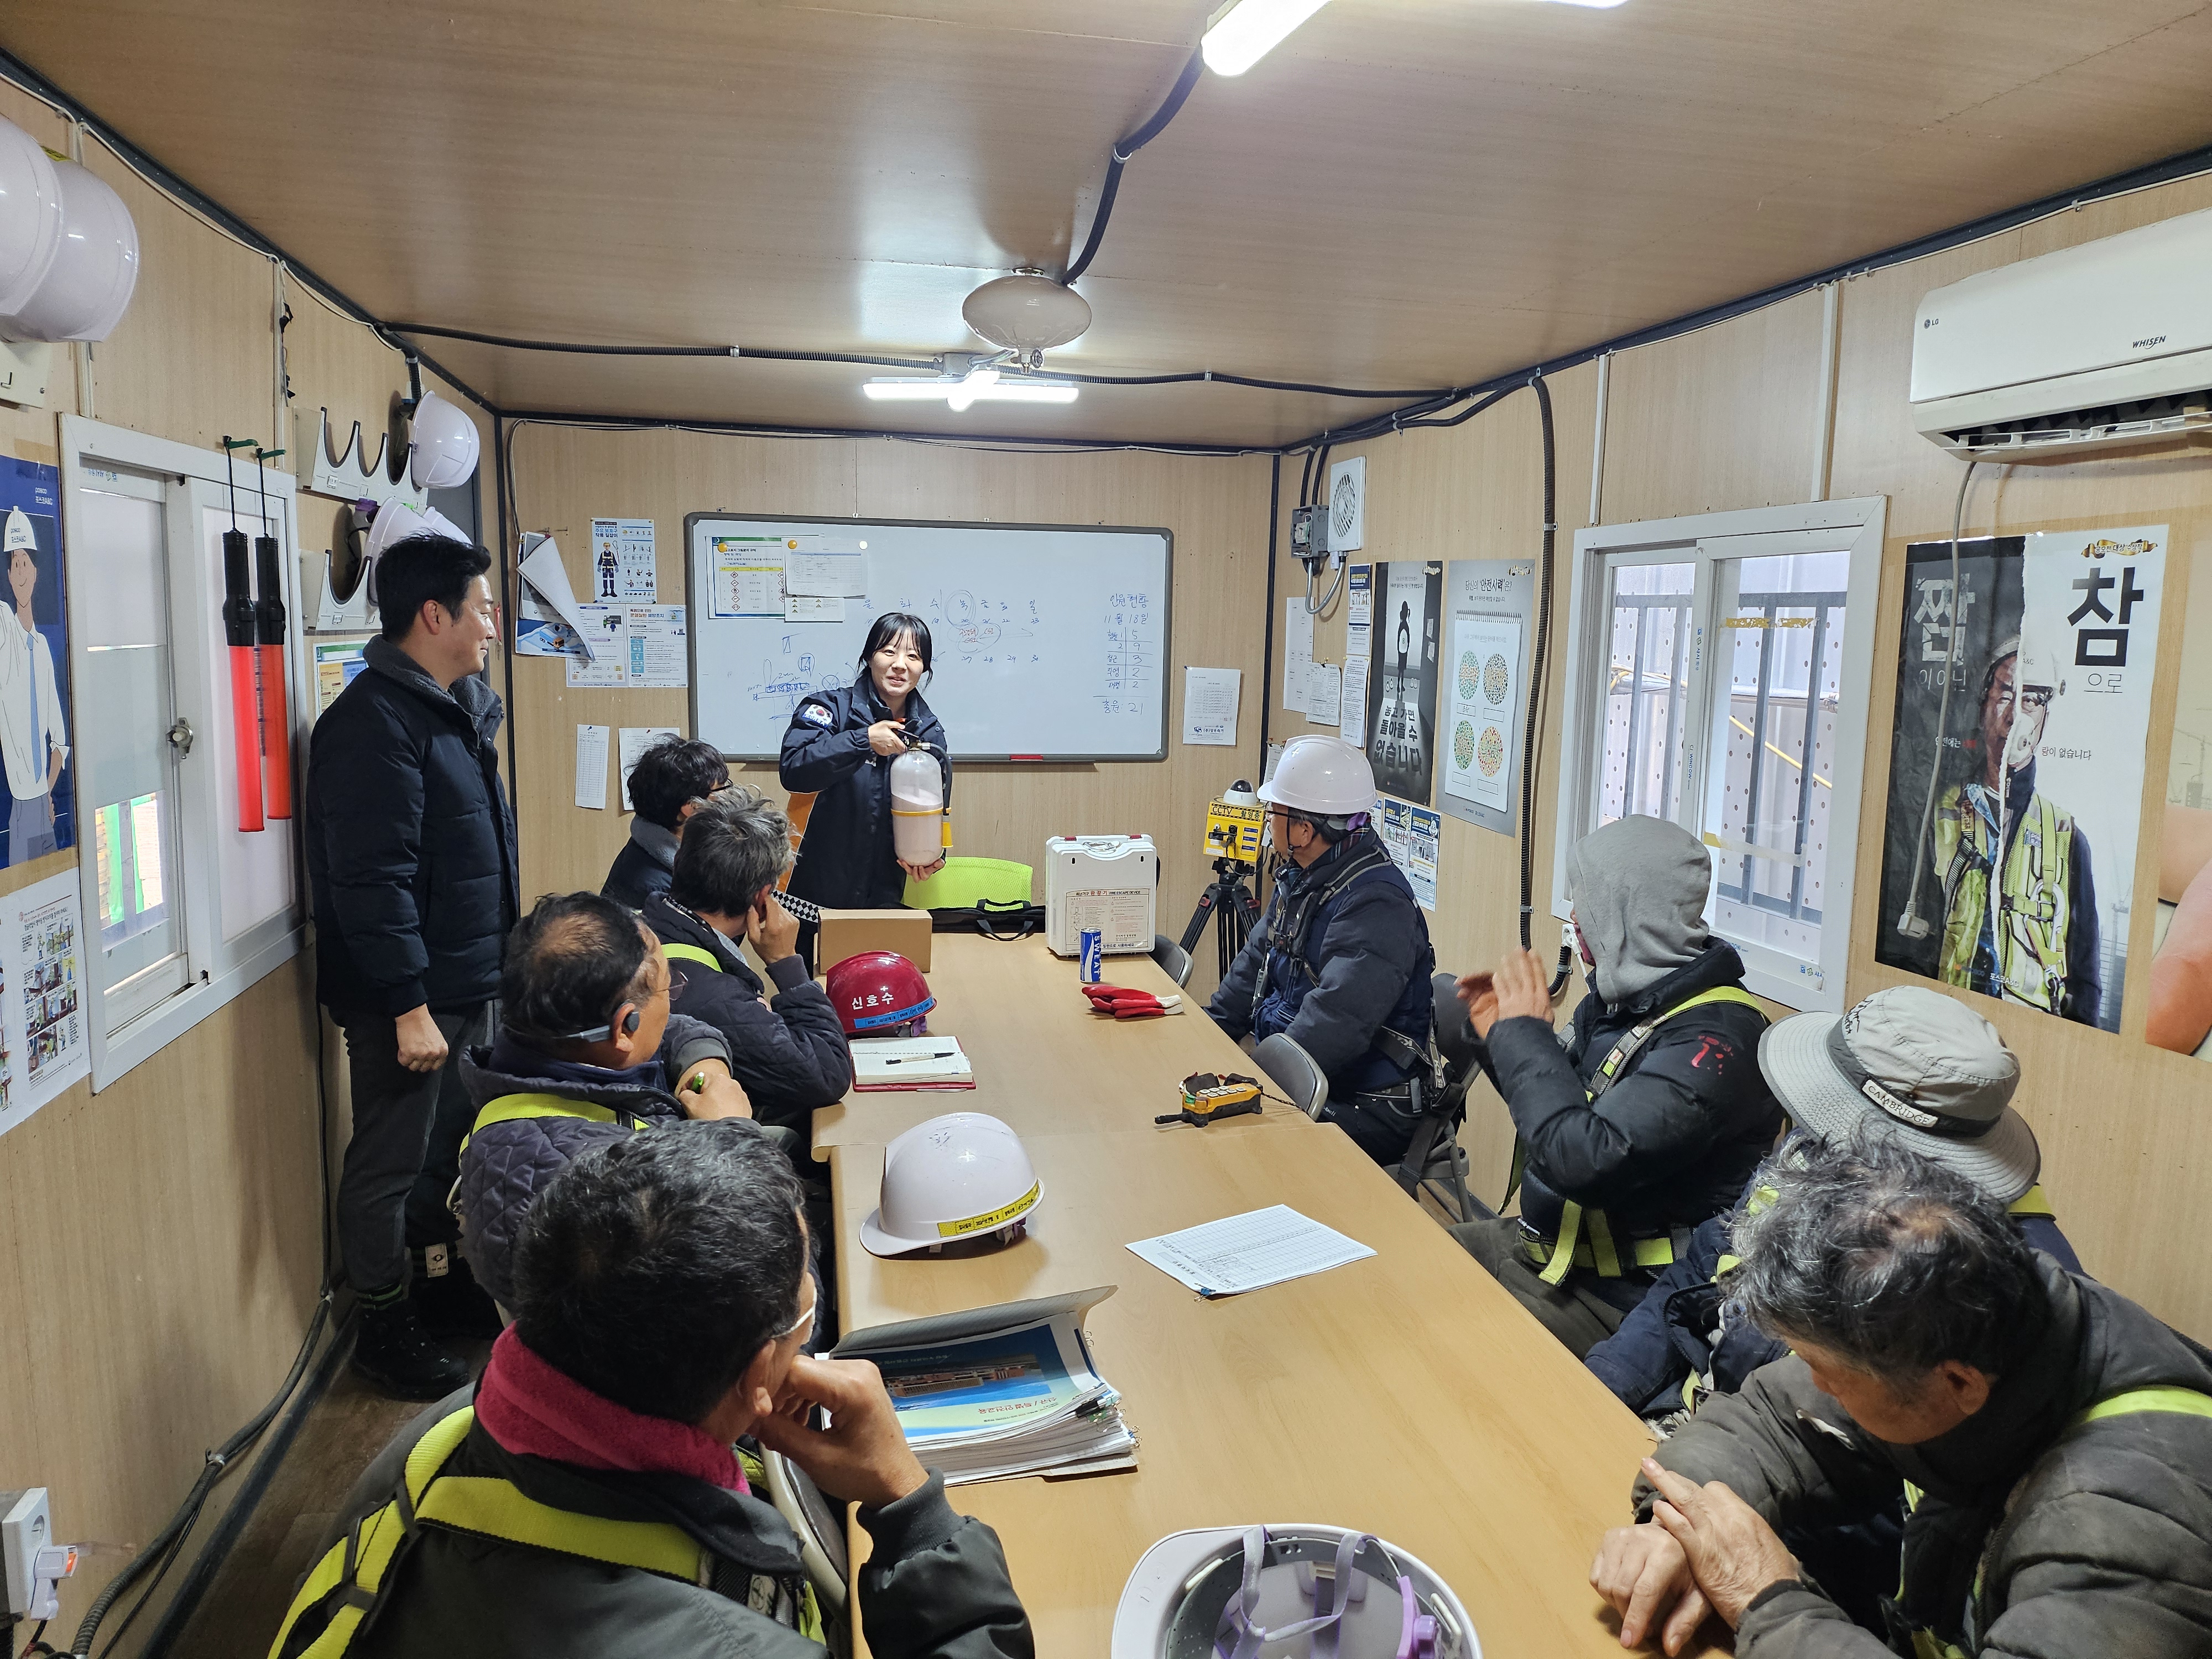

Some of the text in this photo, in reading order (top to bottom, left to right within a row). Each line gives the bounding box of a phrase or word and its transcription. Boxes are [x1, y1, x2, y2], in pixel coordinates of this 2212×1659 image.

[2132, 335, 2166, 349] WHISEN
[1465, 580, 1479, 591] 당신의
[900, 597, 912, 608] 화
[930, 598, 940, 609] 수
[1029, 599, 1037, 614] 일
[1110, 593, 1149, 608] 인원 현황
[2067, 567, 2144, 667] 참
[1132, 630, 1138, 640] 5
[1133, 642, 1140, 651] 9
[1133, 655, 1142, 664] 3
[1107, 666, 1140, 677] 직영 2
[2084, 673, 2123, 693] 으로
[1128, 703, 1143, 715] 21
[1385, 705, 1416, 722] 놓고 가면
[1380, 719, 1418, 742] 돌아올 수
[1373, 739, 1422, 776] 없습니다
[2059, 748, 2092, 760] 없습니다
[1212, 806, 1233, 815] CCTV
[1989, 973, 2019, 987] 포스코A&C
[852, 992, 894, 1010] 신호수
[1868, 1085, 1929, 1125] CAMBRIDGE
[1015, 1402, 1032, 1410] 특별
[1039, 1396, 1057, 1406] 신규
[978, 1405, 1014, 1415] 안전교육
